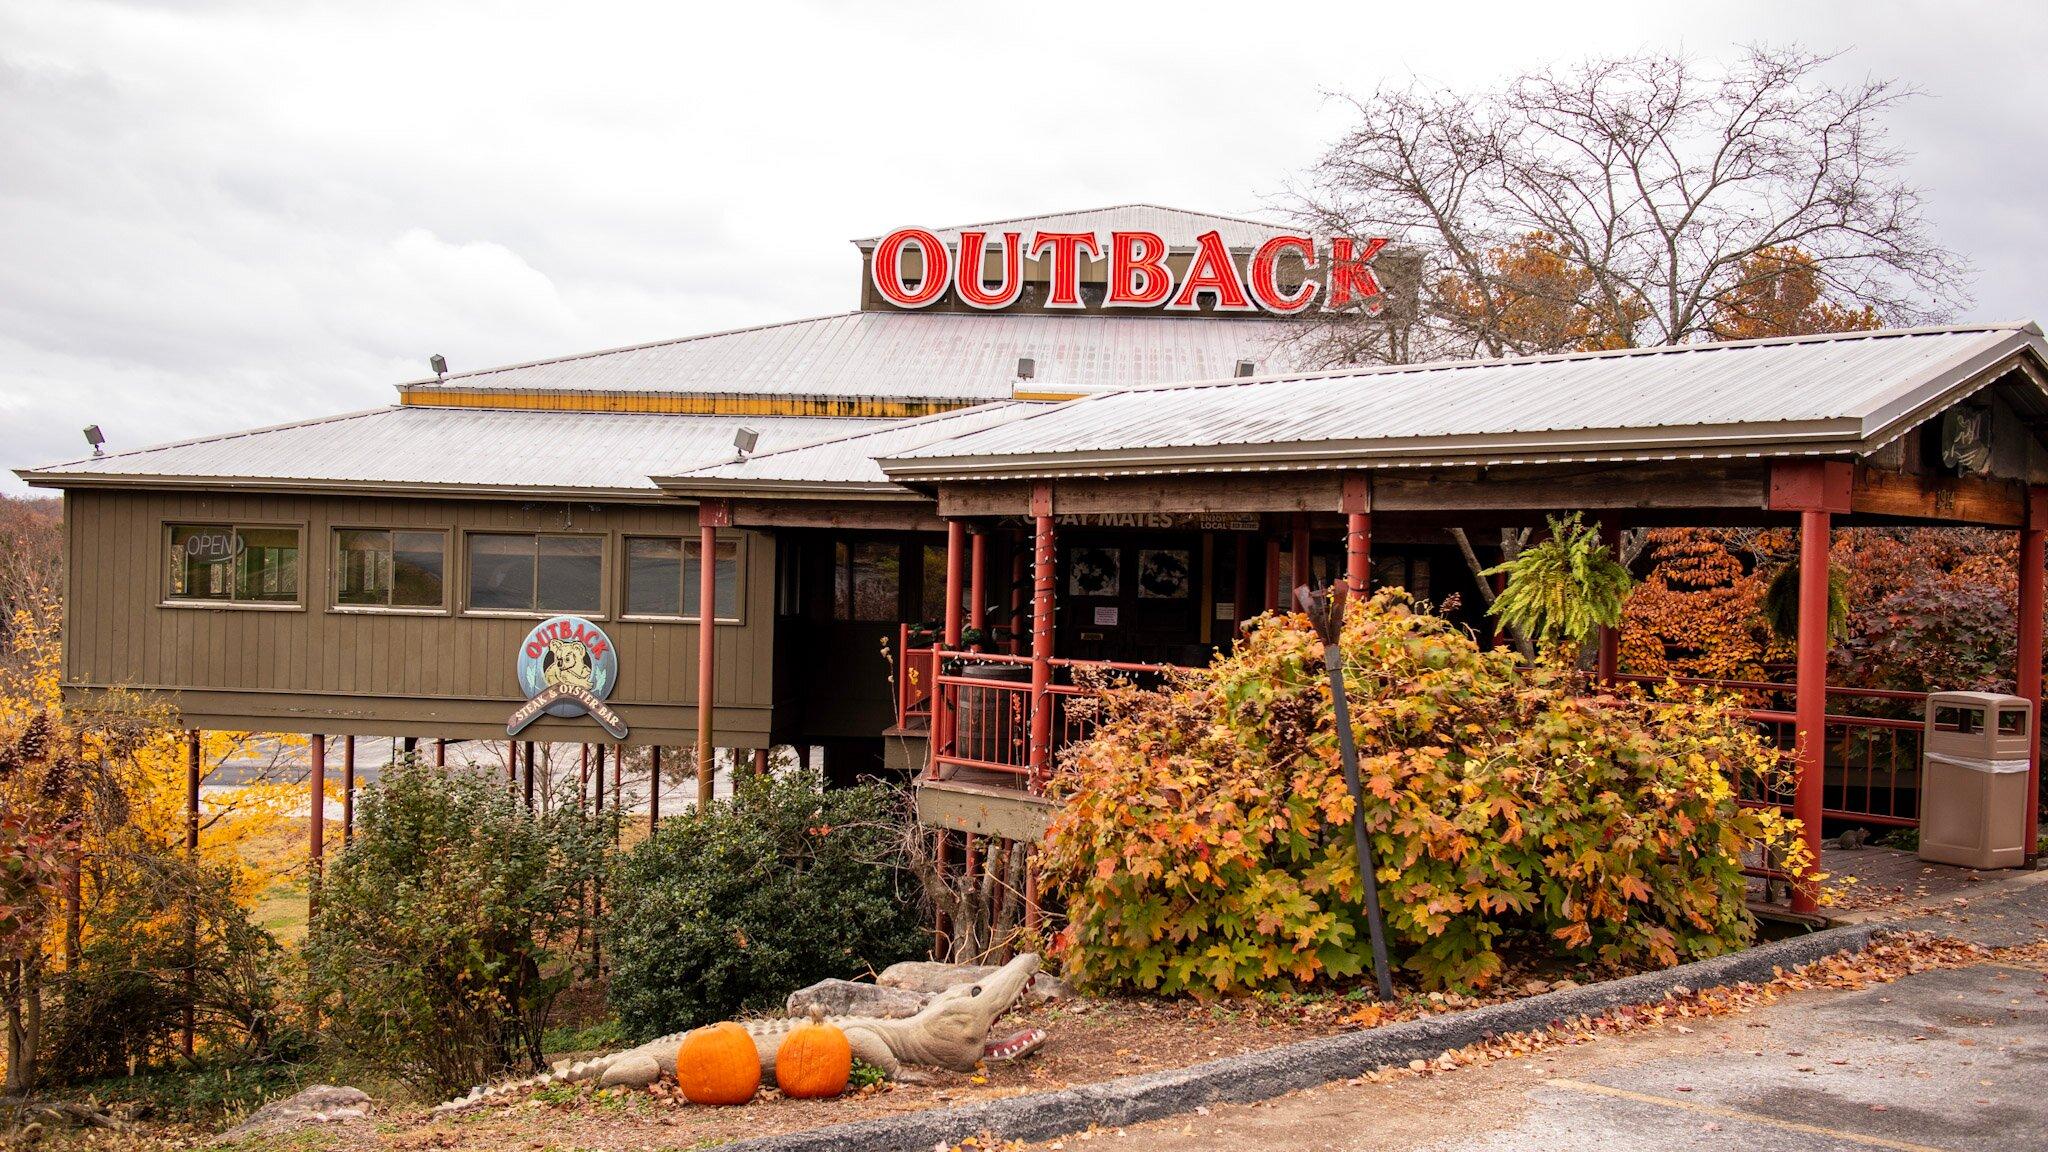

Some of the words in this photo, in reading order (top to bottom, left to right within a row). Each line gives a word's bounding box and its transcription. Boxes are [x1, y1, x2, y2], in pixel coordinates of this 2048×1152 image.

[872, 226, 1391, 315] OUTBACK
[1097, 513, 1173, 528] MATES
[1200, 522, 1228, 530] LOCAL
[187, 535, 233, 555] OPEN
[525, 620, 609, 660] OUTBACK
[515, 697, 548, 721] STEAK
[548, 690, 558, 699] &
[559, 684, 598, 709] OYSTER
[598, 706, 620, 727] BAR
